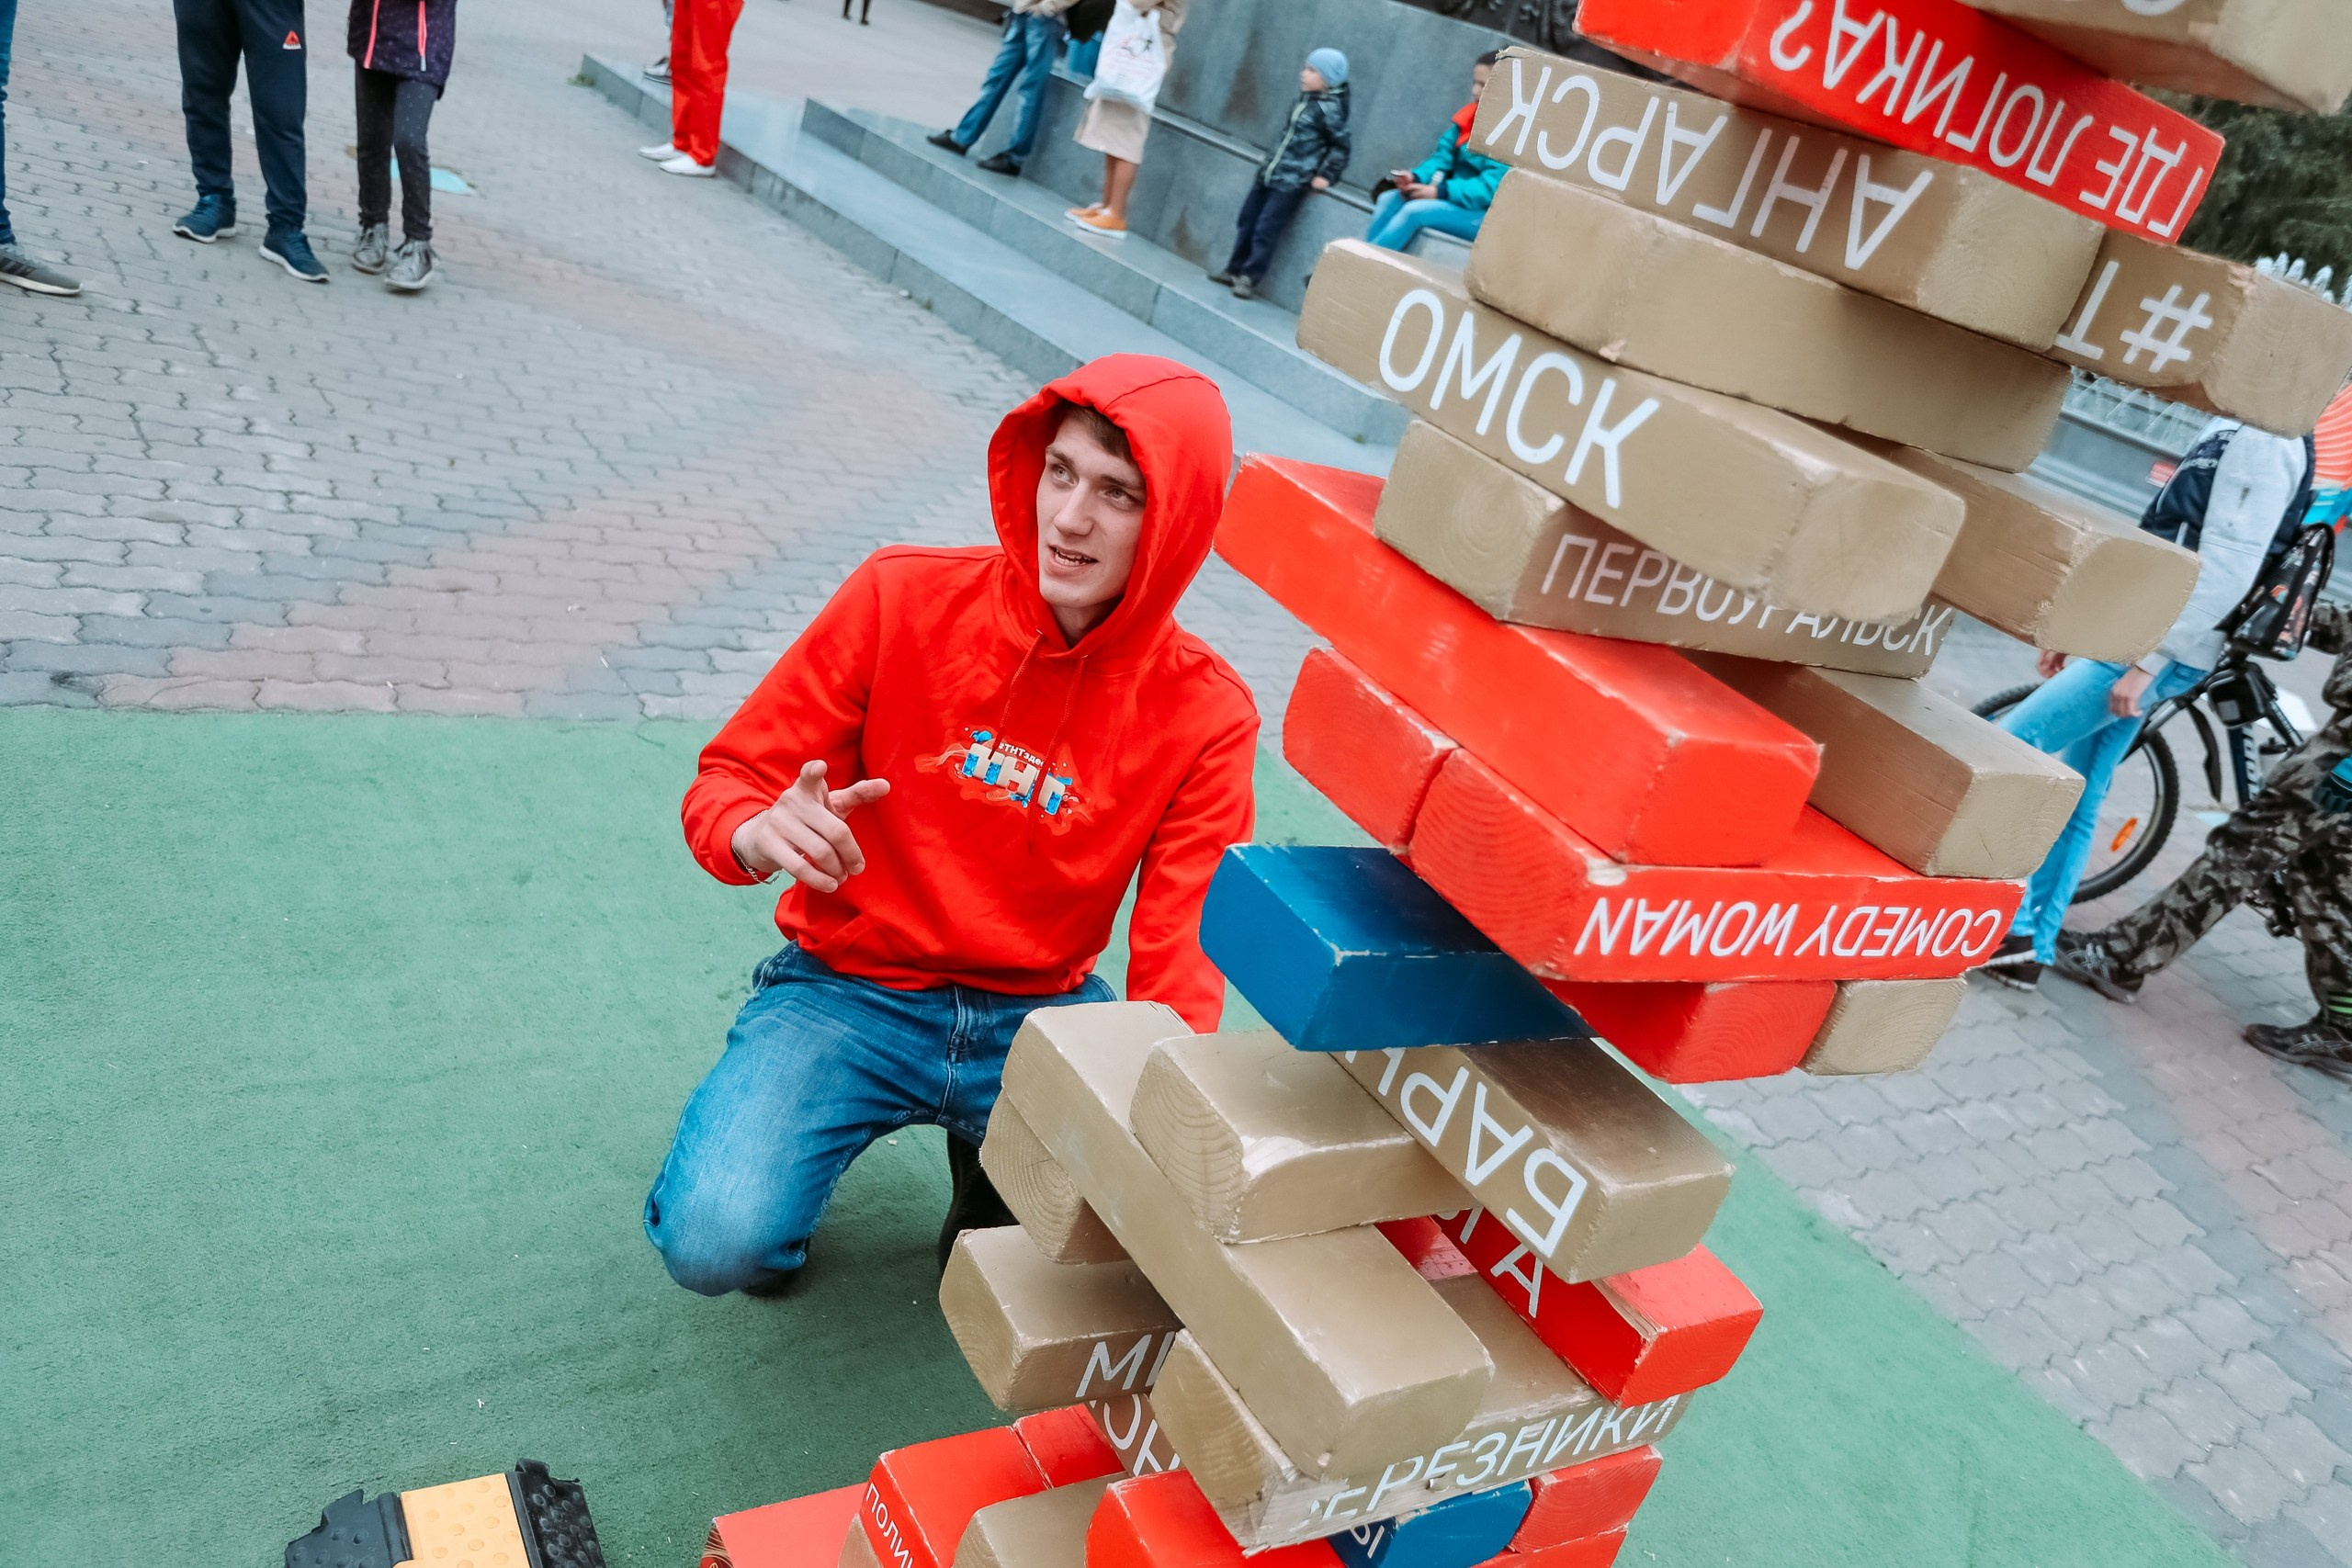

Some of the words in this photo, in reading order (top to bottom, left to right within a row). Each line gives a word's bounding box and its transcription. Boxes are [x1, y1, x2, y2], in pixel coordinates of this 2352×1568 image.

[1769, 0, 2095, 187] ЛОГИКА?
[1485, 58, 1935, 271] АНГАРСК
[2078, 125, 2204, 239] ГДЕ
[1379, 288, 1660, 509] ОМСК
[1573, 897, 1800, 957] WOMAN
[1794, 904, 2002, 958] COMEDY
[1308, 1393, 1681, 1522] ЕРЕЗНИКИ
[865, 1482, 914, 1568] ПОЛИ
